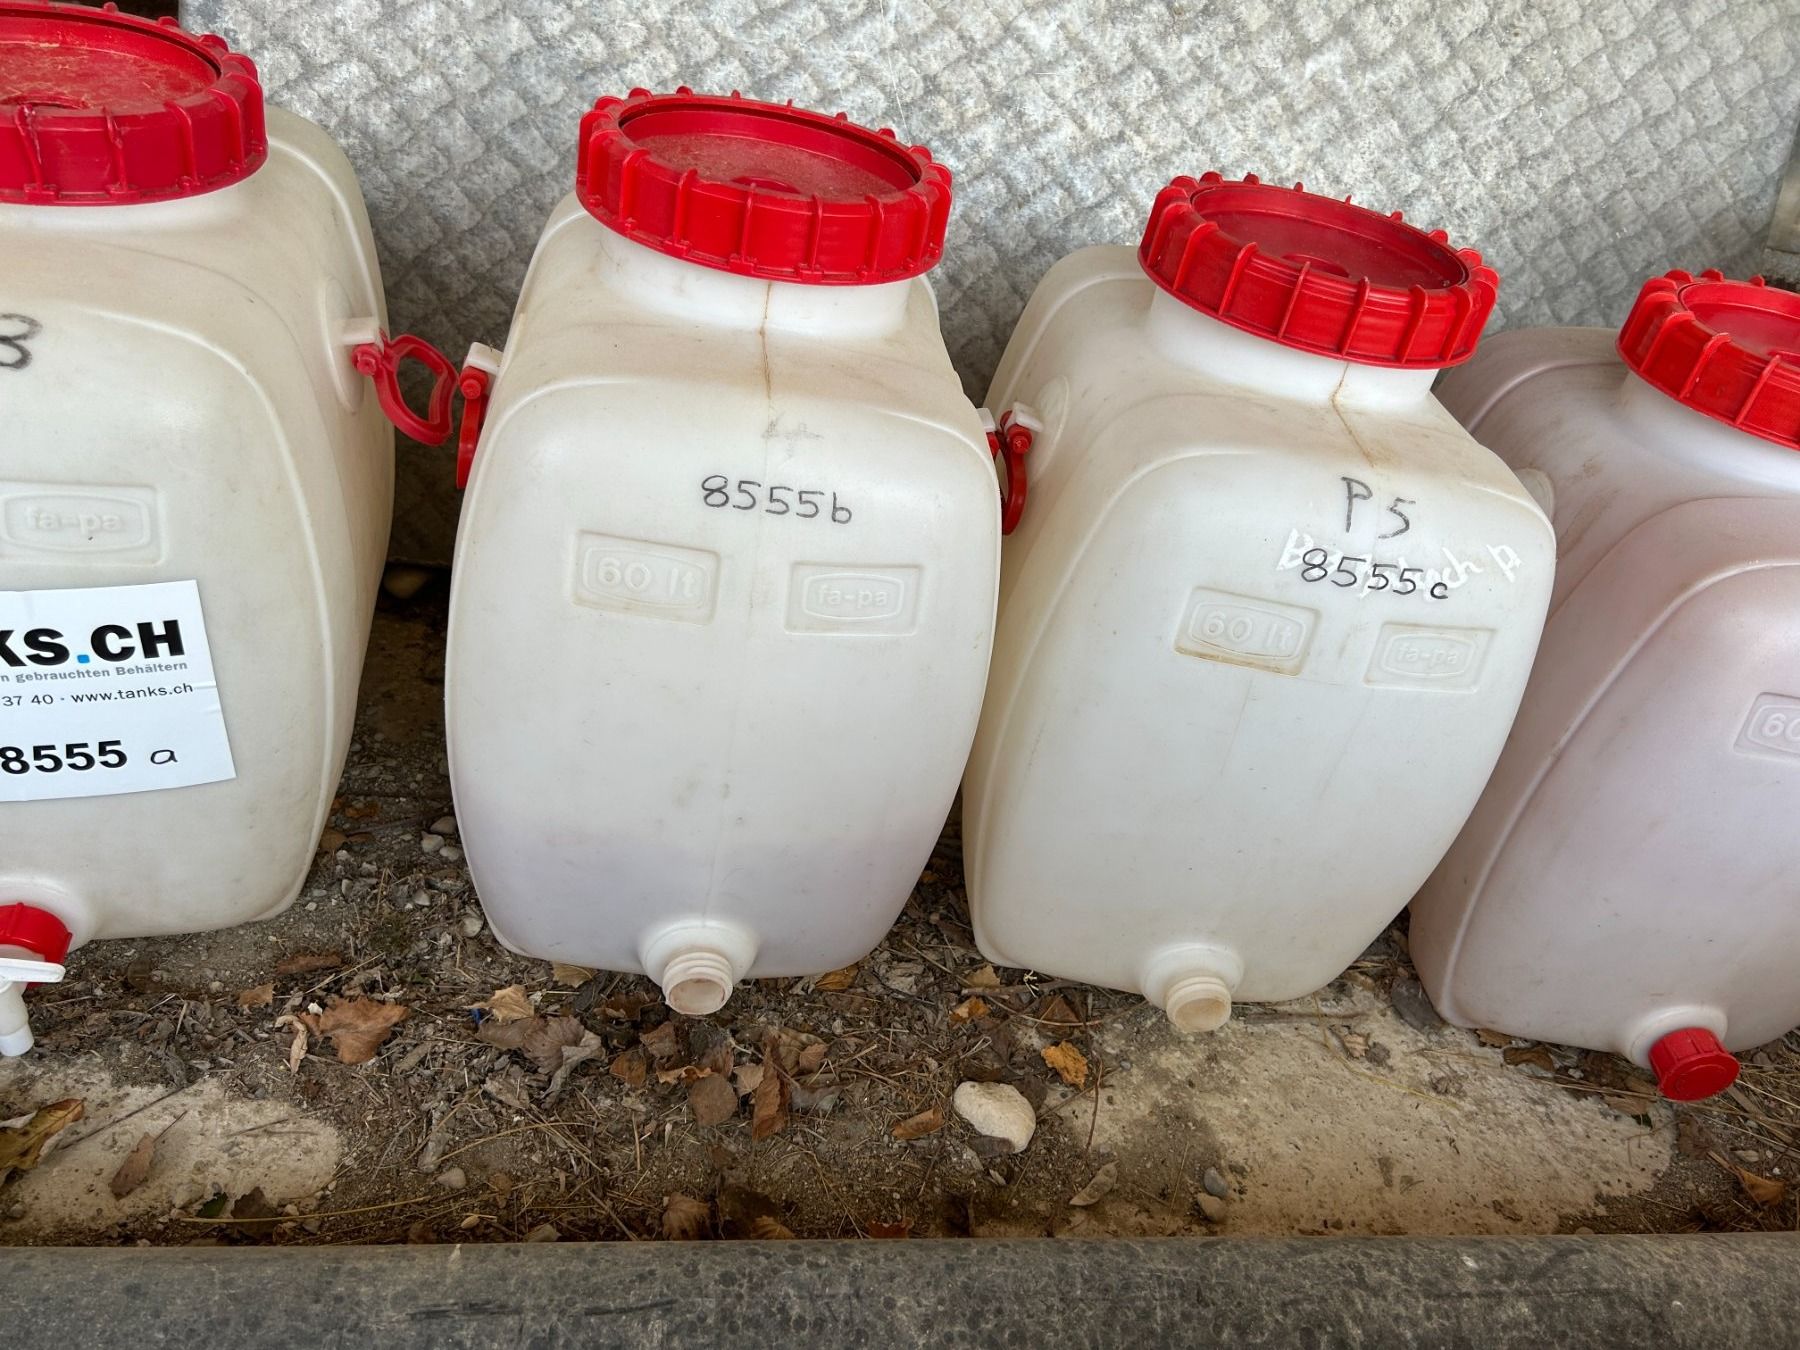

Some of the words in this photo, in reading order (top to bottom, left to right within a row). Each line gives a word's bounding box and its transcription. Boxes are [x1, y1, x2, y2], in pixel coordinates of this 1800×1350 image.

[701, 475, 852, 524] 8555b
[1340, 476, 1373, 533] P
[1378, 497, 1416, 539] 5
[598, 557, 652, 593] 60
[1301, 548, 1449, 600] 8555c
[817, 583, 890, 608] fa-pa
[1203, 610, 1254, 642] 60
[1398, 641, 1463, 668] fa-pa
[16, 669, 110, 684] gebrauchten
[116, 662, 188, 676] Behältern
[2, 695, 22, 707] 37
[31, 694, 54, 705] 40
[71, 683, 194, 703] www.tanks.ch
[0, 739, 128, 775] 8555
